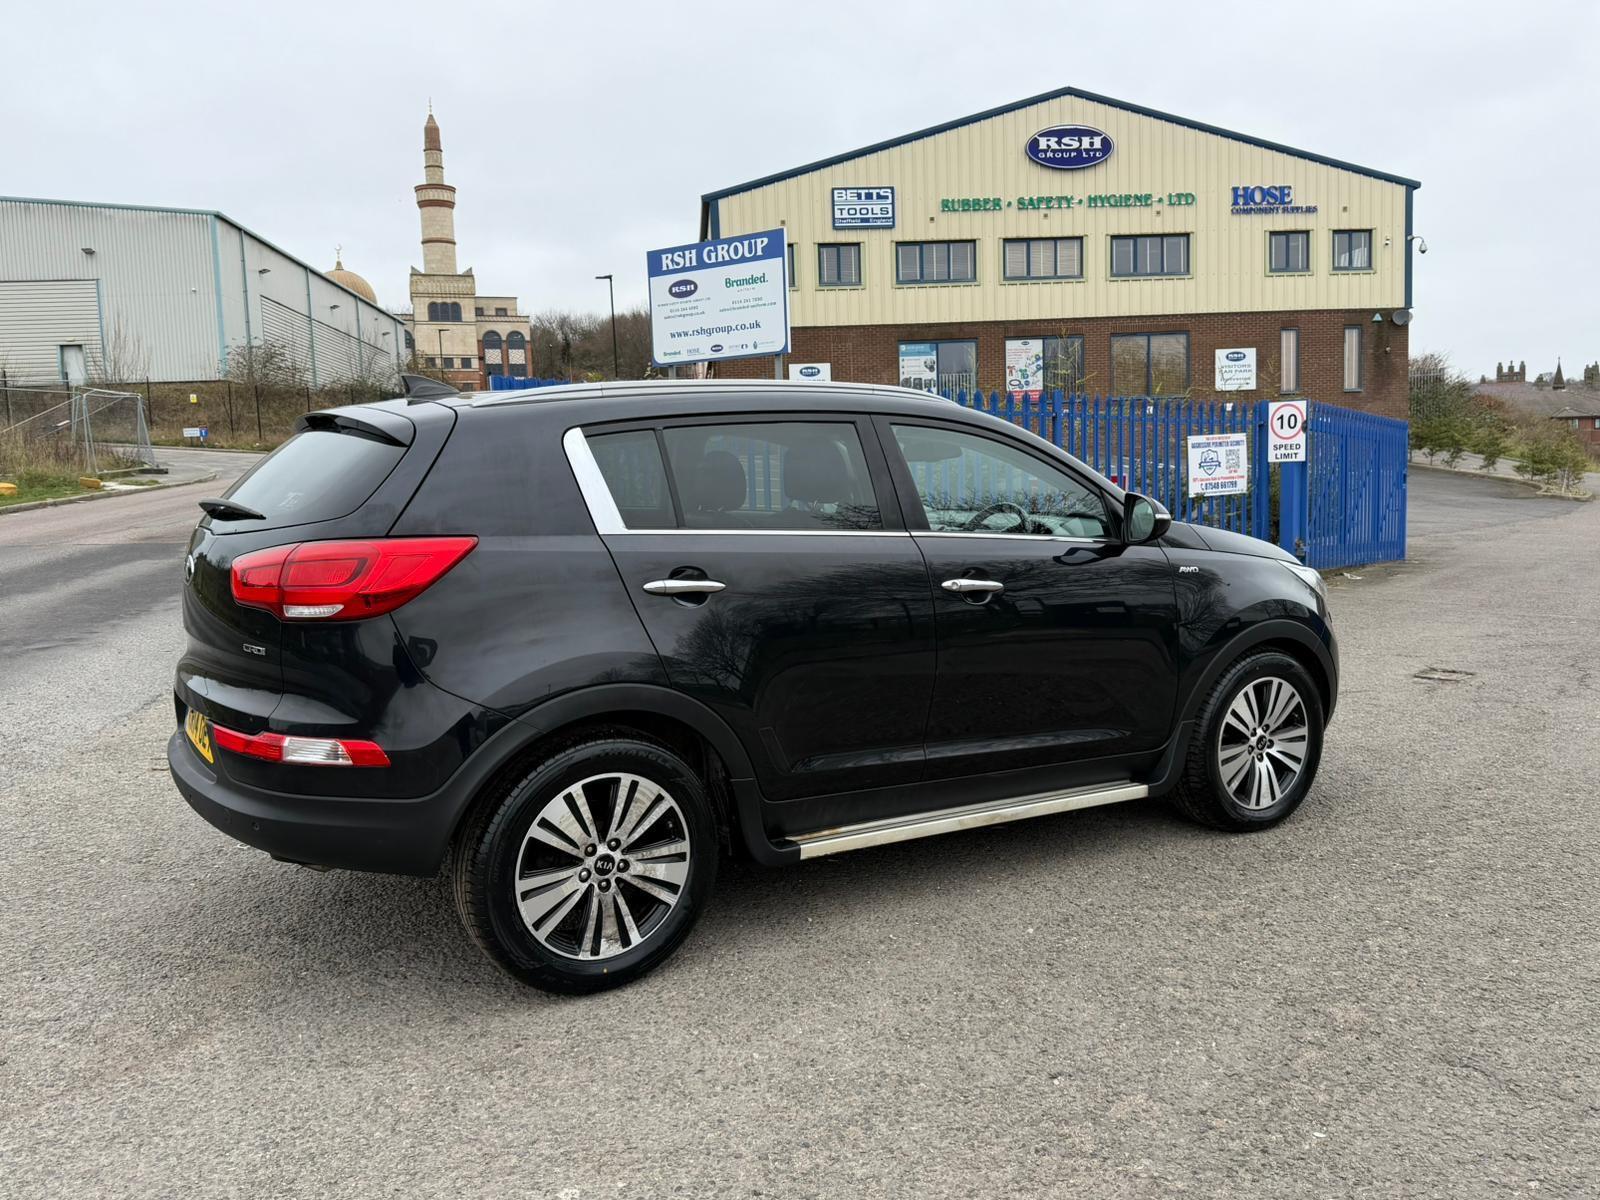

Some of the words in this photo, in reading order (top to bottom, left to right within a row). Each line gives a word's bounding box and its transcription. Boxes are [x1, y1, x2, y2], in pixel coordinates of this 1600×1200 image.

[1038, 136, 1102, 149] RSH
[833, 189, 892, 202] BETTS
[941, 198, 1002, 212] RUBBER
[1017, 195, 1073, 210] SAFETY
[1087, 193, 1152, 208] HYGIENE
[1167, 192, 1196, 206] LTD
[1230, 185, 1293, 206] HOSE
[836, 207, 890, 216] TOOLS
[1231, 206, 1280, 214] COMPONENT
[1281, 205, 1318, 214] SUPPLIES
[661, 249, 697, 270] RSH
[702, 237, 769, 264] GROUP
[671, 284, 695, 293] RSH
[669, 320, 761, 339] www.rshgroup.co.uk
[1276, 413, 1298, 430] 10
[1273, 443, 1301, 451] SPEED
[1274, 452, 1299, 460] LIMIT
[596, 860, 613, 870] KIA
